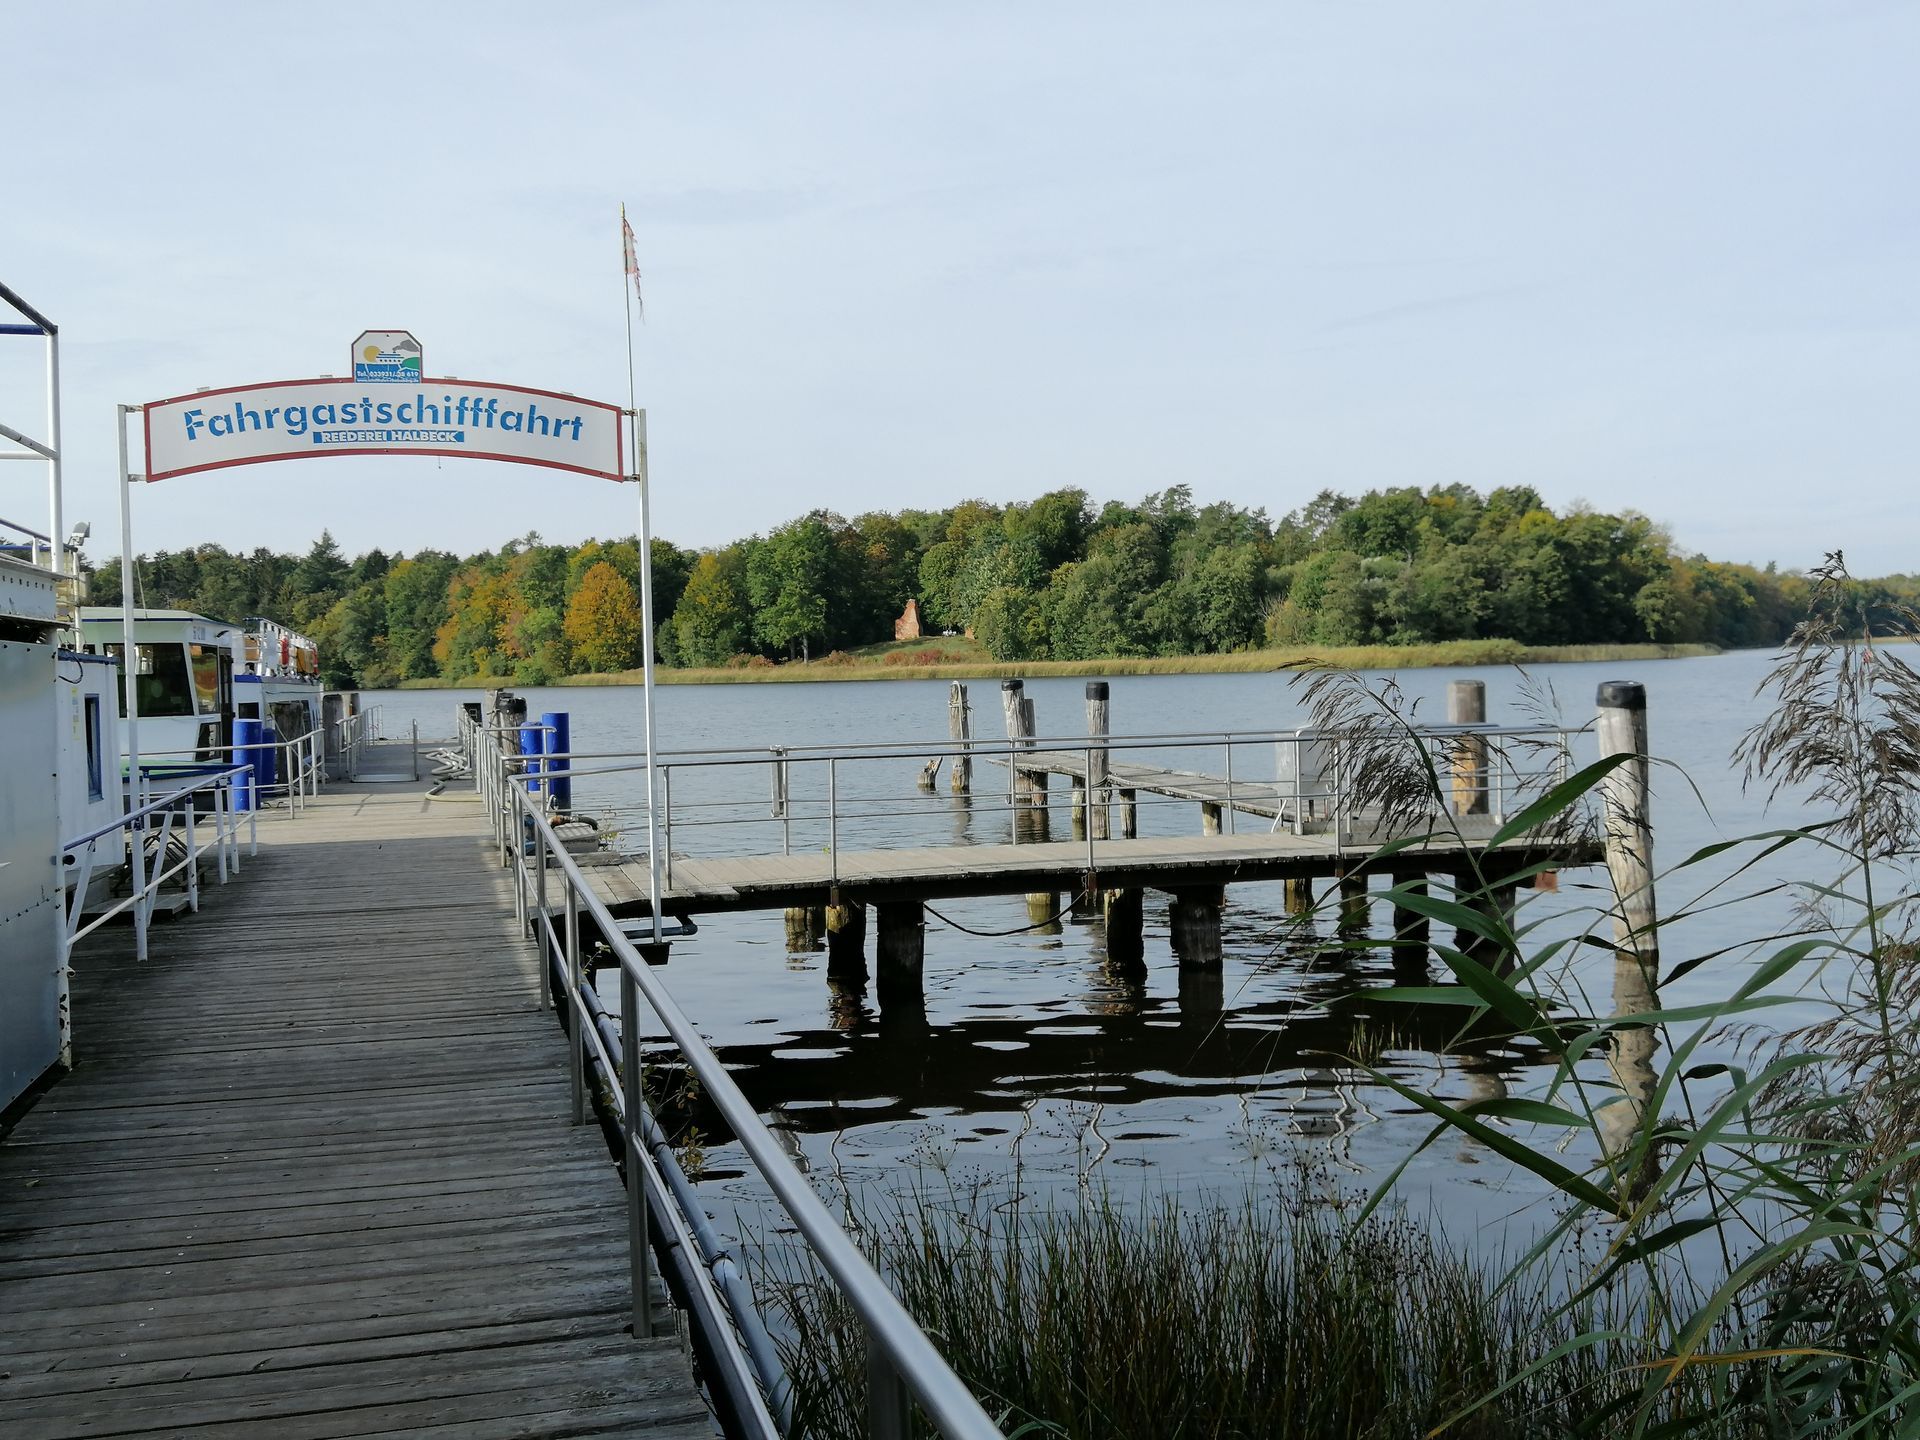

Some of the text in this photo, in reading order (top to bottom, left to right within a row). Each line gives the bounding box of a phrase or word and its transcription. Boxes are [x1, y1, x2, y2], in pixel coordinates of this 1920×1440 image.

[184, 394, 583, 441] Fahrgastschifffahrt
[322, 430, 457, 442] REEDEREI HALBECK
